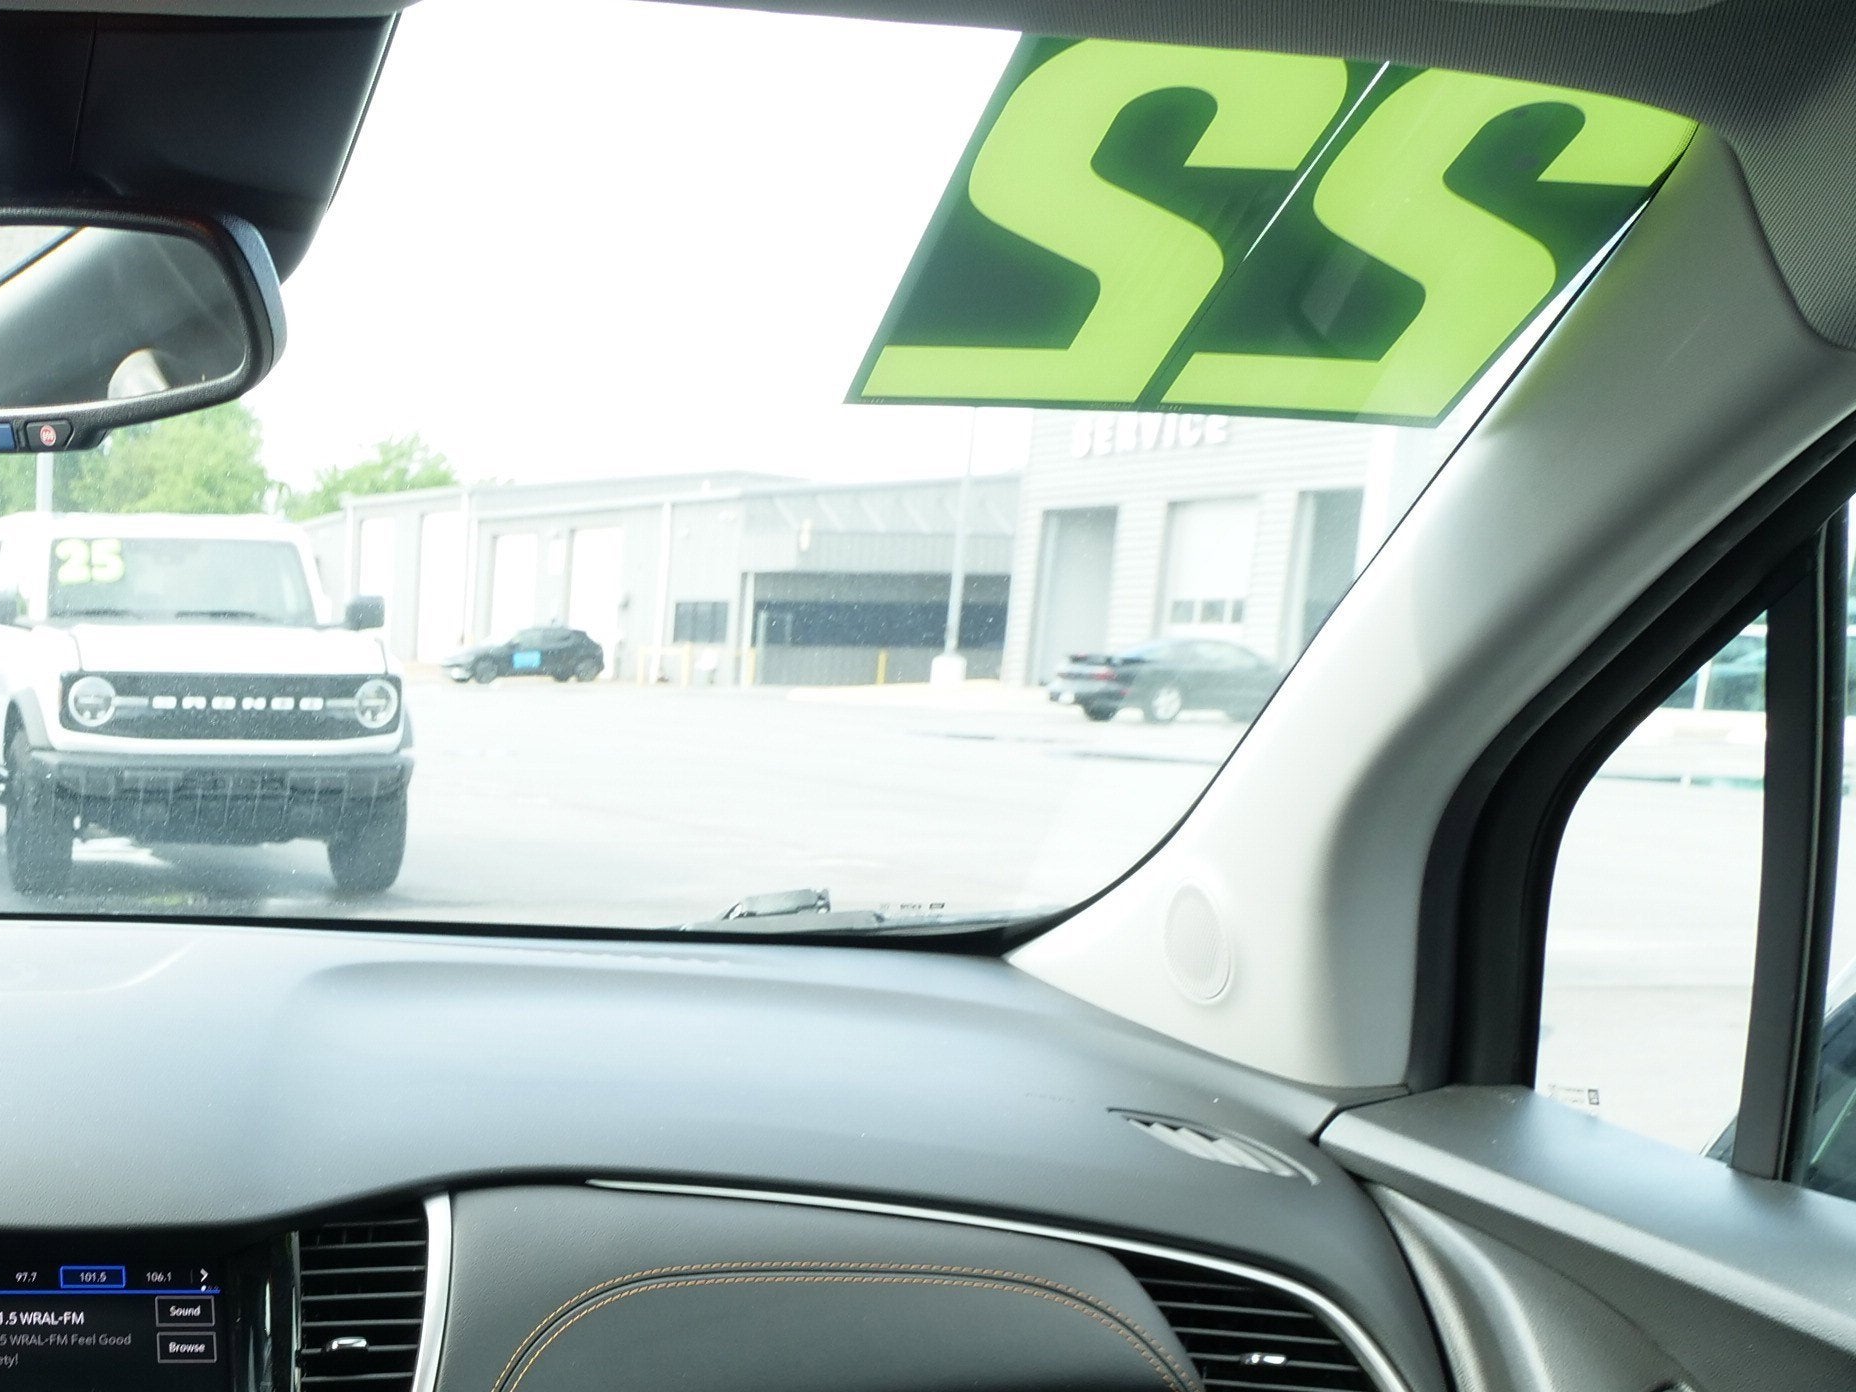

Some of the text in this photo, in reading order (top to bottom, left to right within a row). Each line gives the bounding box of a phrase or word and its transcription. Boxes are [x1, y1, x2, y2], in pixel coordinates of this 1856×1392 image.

[54, 538, 126, 587] 25
[15, 1271, 38, 1283] 97.7
[79, 1271, 107, 1283] 101.5
[145, 1271, 173, 1283] 106.1
[19, 1311, 85, 1327] WRAL-FM
[168, 1305, 202, 1318] Sound
[9, 1333, 69, 1347] WRAL-FM
[71, 1333, 96, 1347] Feel
[98, 1332, 132, 1346] Good
[168, 1340, 206, 1355] Browse
